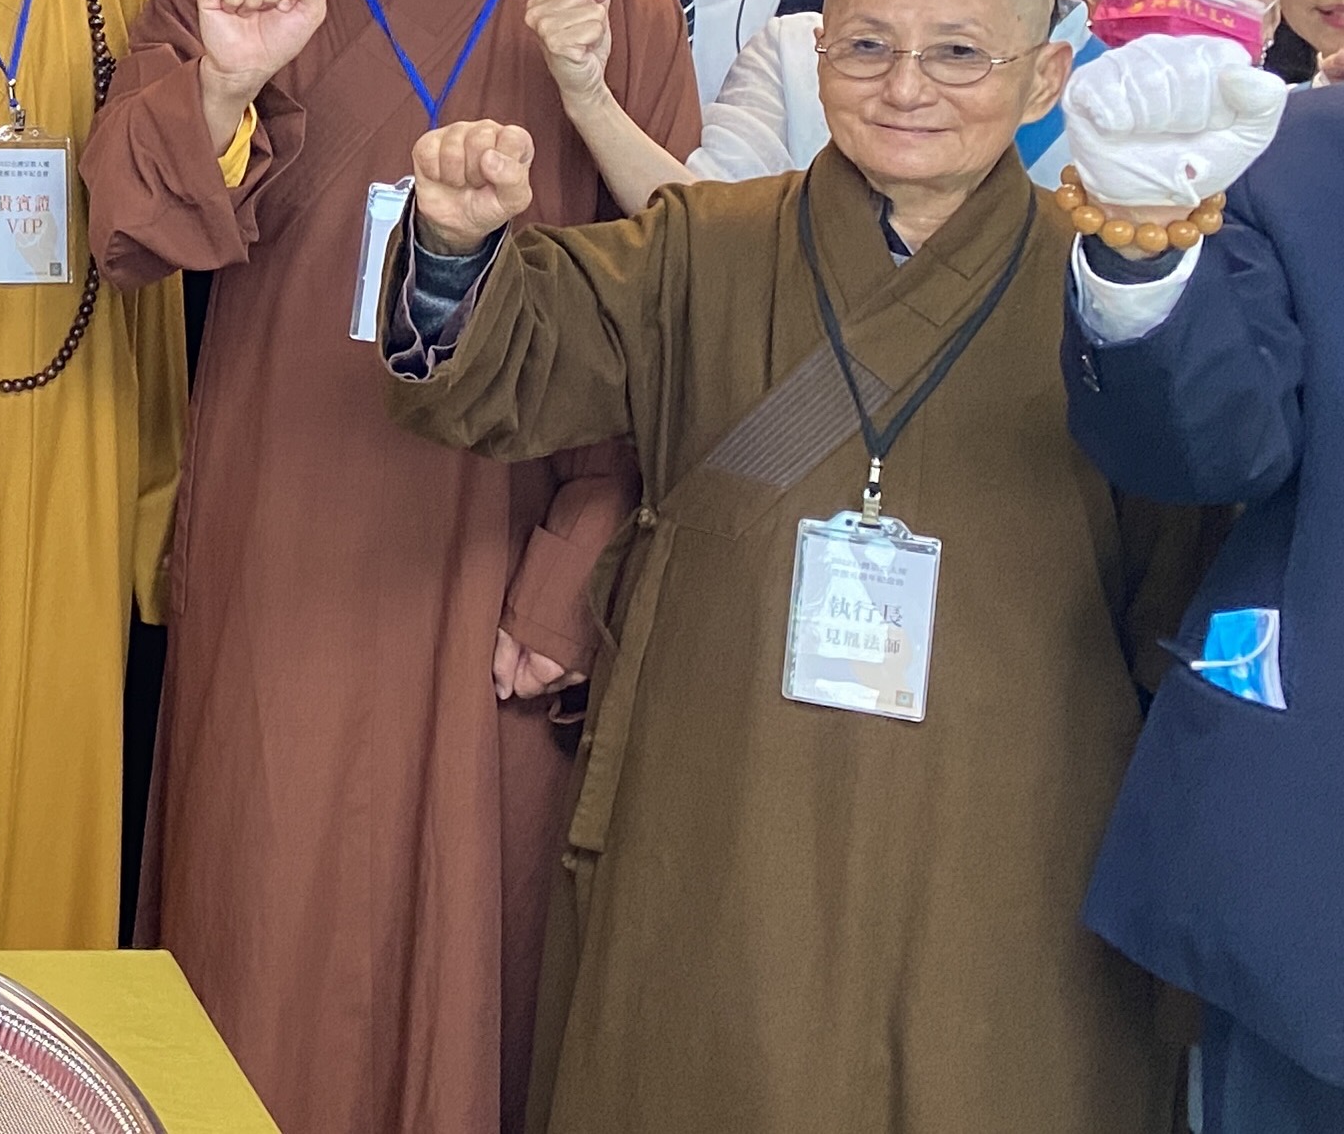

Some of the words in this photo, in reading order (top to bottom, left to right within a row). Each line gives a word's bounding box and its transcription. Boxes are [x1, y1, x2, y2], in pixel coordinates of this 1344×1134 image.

[6, 218, 44, 234] VIP
[829, 596, 904, 628] 執行長
